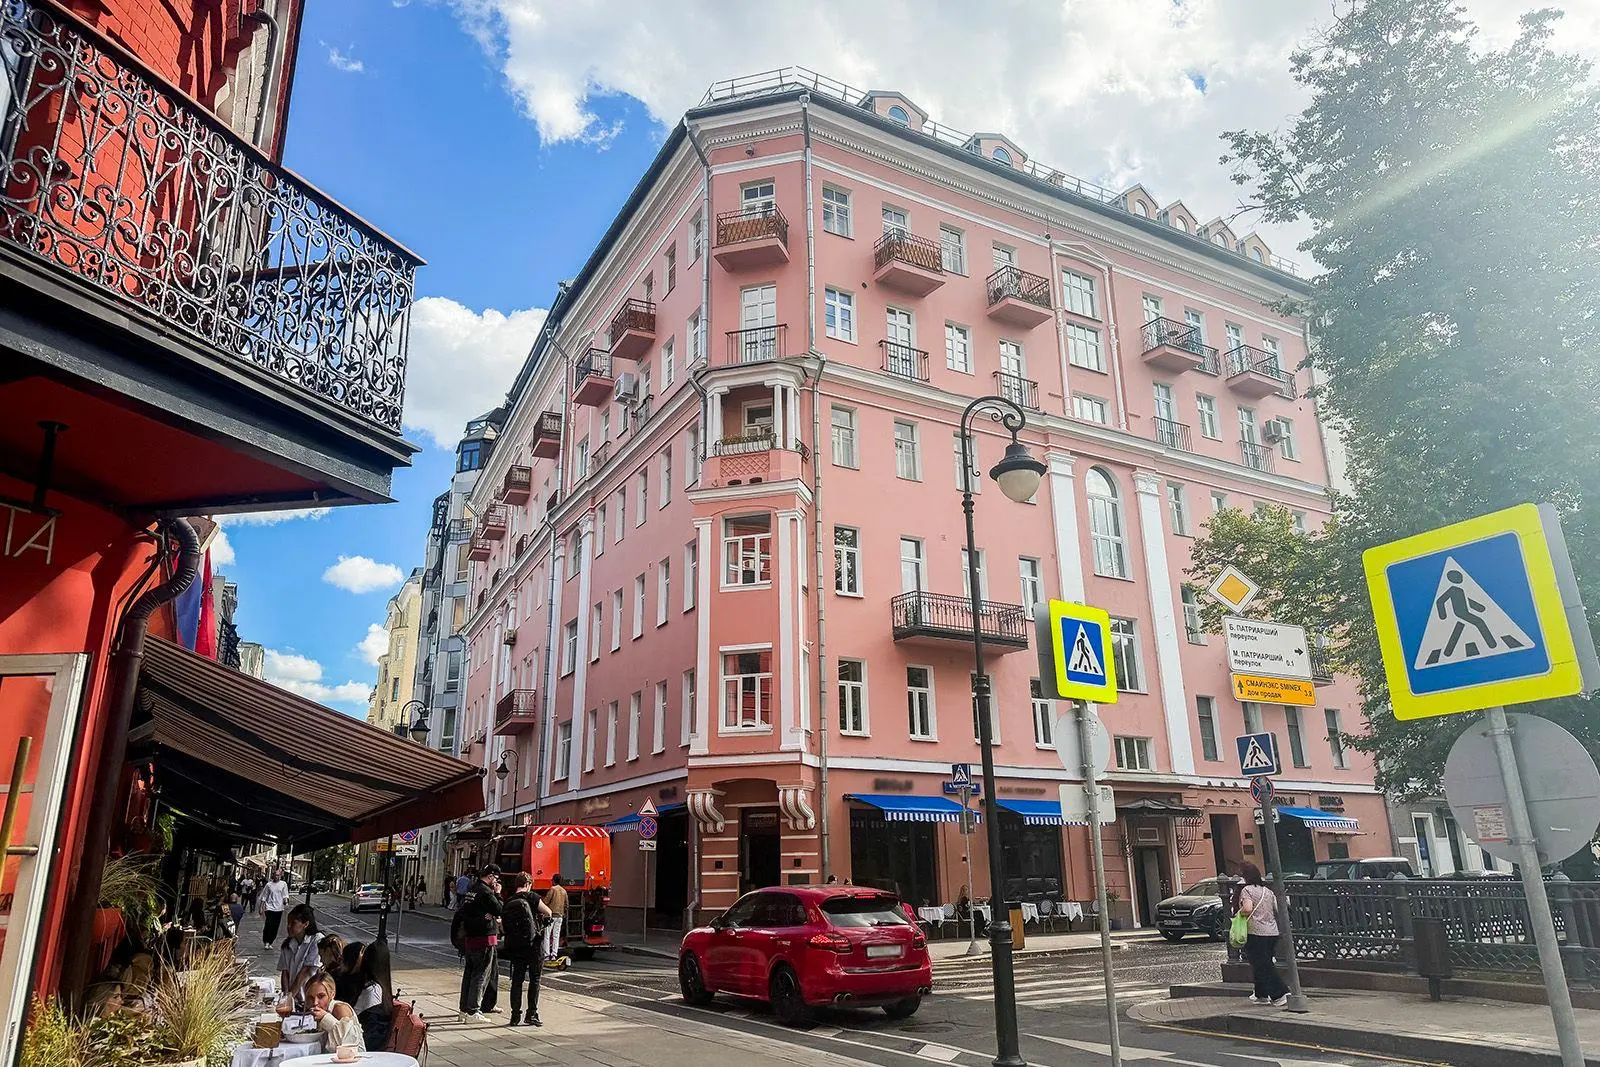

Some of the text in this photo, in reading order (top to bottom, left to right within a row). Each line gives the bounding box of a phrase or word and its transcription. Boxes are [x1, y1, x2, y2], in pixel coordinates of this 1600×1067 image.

[1236, 624, 1279, 637] ПАТРИАРШИЙ
[1230, 632, 1259, 642] переулок
[1232, 650, 1284, 662] М. ПАТРИАРШИЙ
[1234, 658, 1263, 668] переулок
